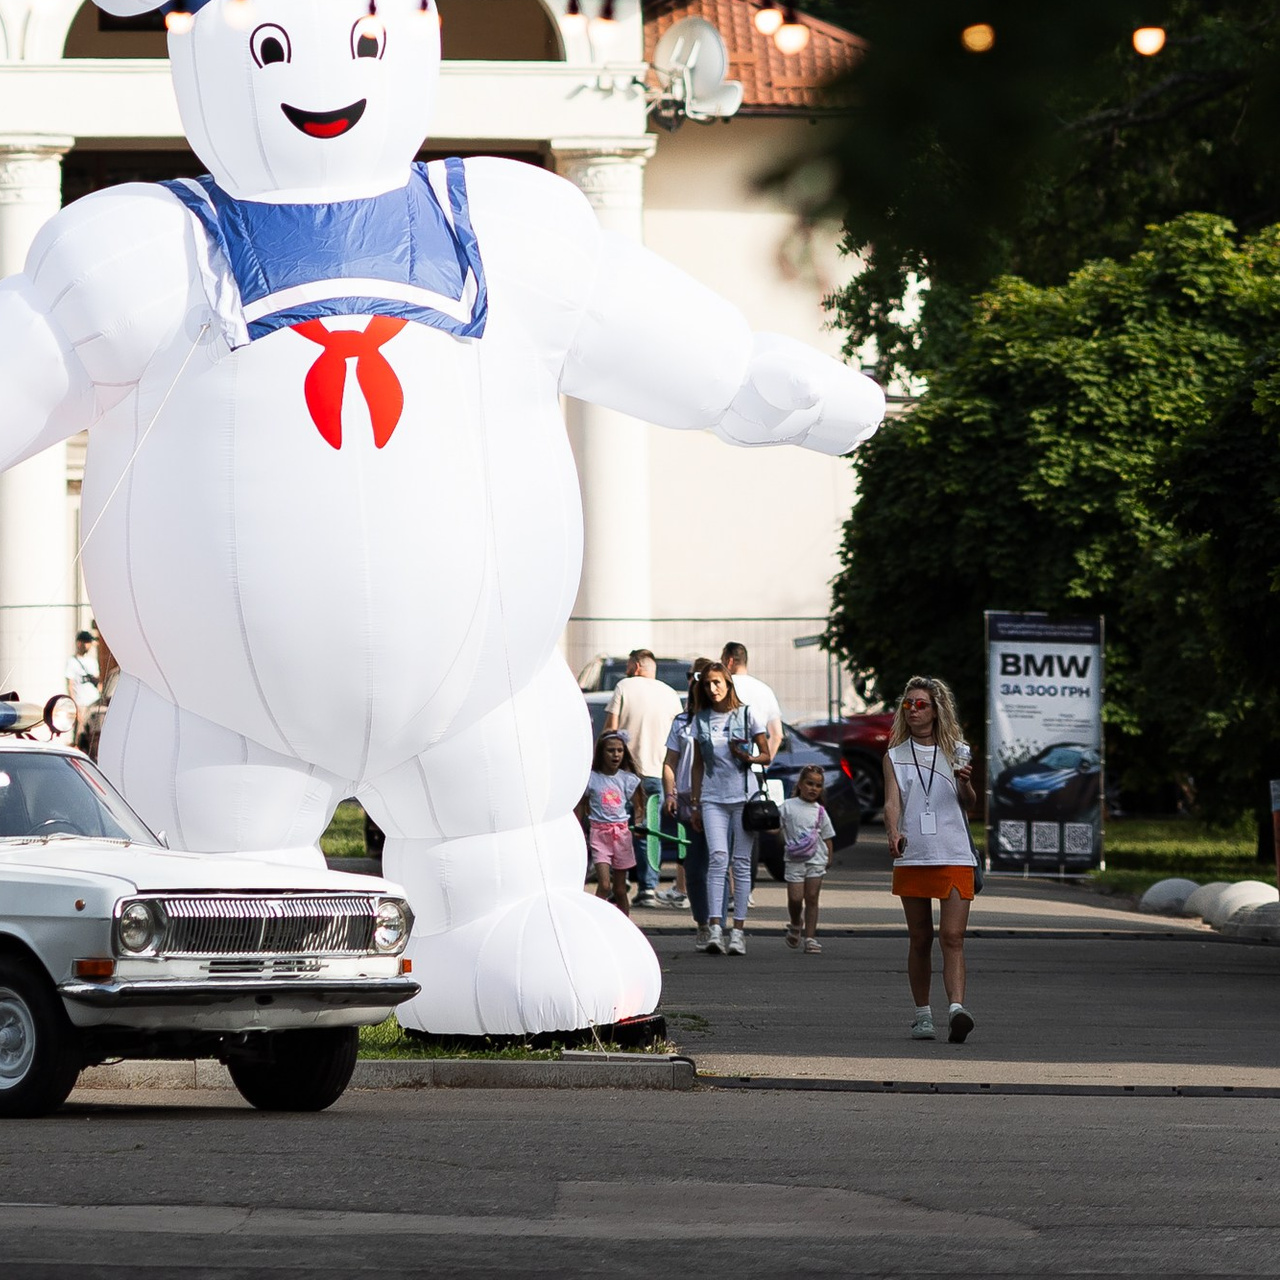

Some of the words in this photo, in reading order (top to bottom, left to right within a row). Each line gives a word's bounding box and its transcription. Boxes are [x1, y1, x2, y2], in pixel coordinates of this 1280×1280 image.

[1000, 653, 1091, 679] BMW
[1000, 683, 1022, 696] ЗА
[1025, 684, 1058, 697] 300
[1060, 685, 1091, 698] ГРН
